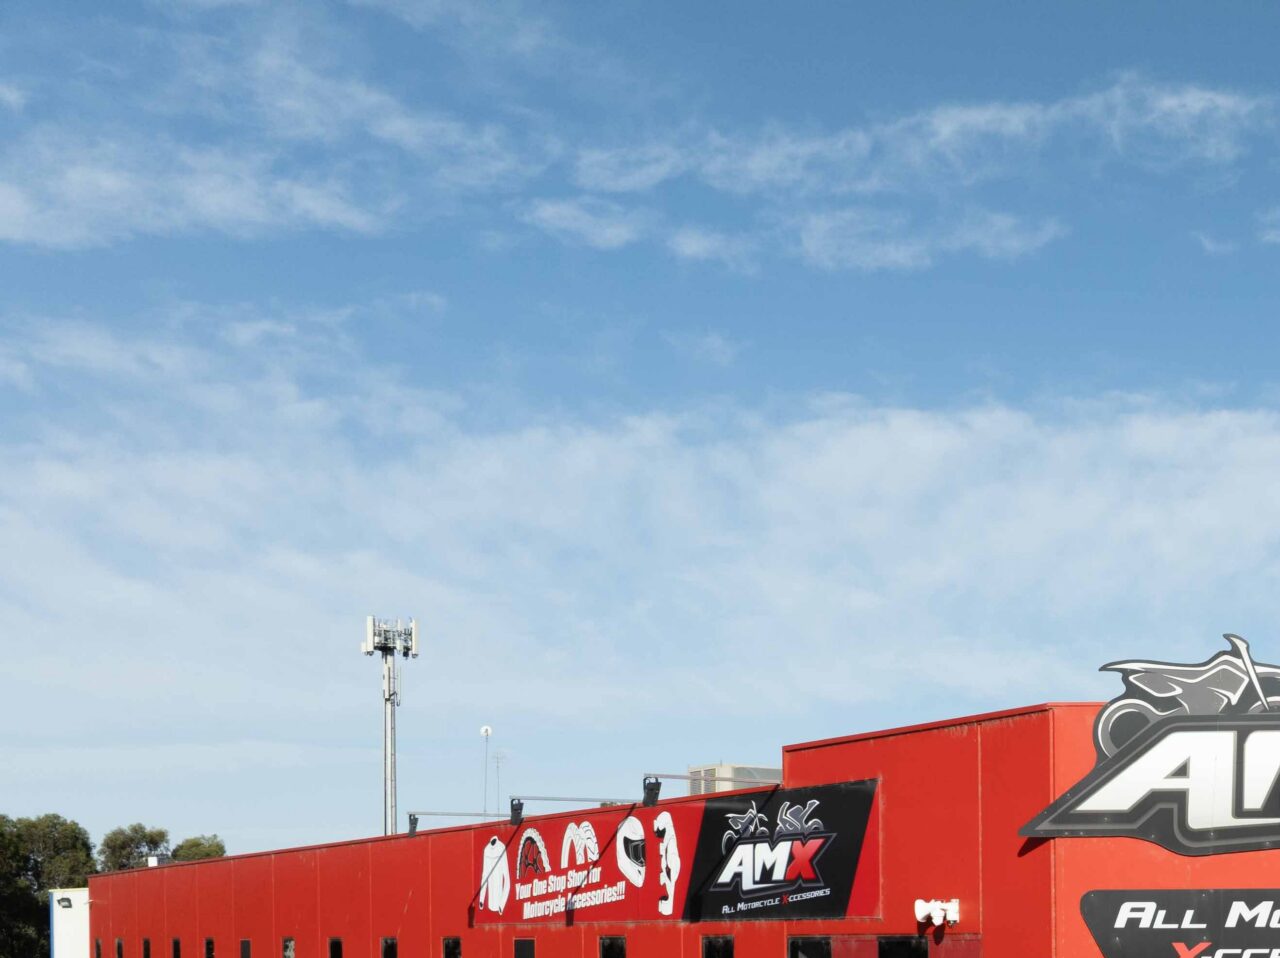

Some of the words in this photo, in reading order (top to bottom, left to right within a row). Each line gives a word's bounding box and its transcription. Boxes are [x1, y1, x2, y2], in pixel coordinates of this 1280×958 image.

[717, 838, 825, 891] AMX
[515, 883, 533, 900] Your
[532, 879, 547, 897] One
[548, 875, 566, 892] Stop
[567, 869, 587, 889] Shop
[523, 894, 566, 920] Motorcycle
[566, 881, 626, 910] Accessories!!!
